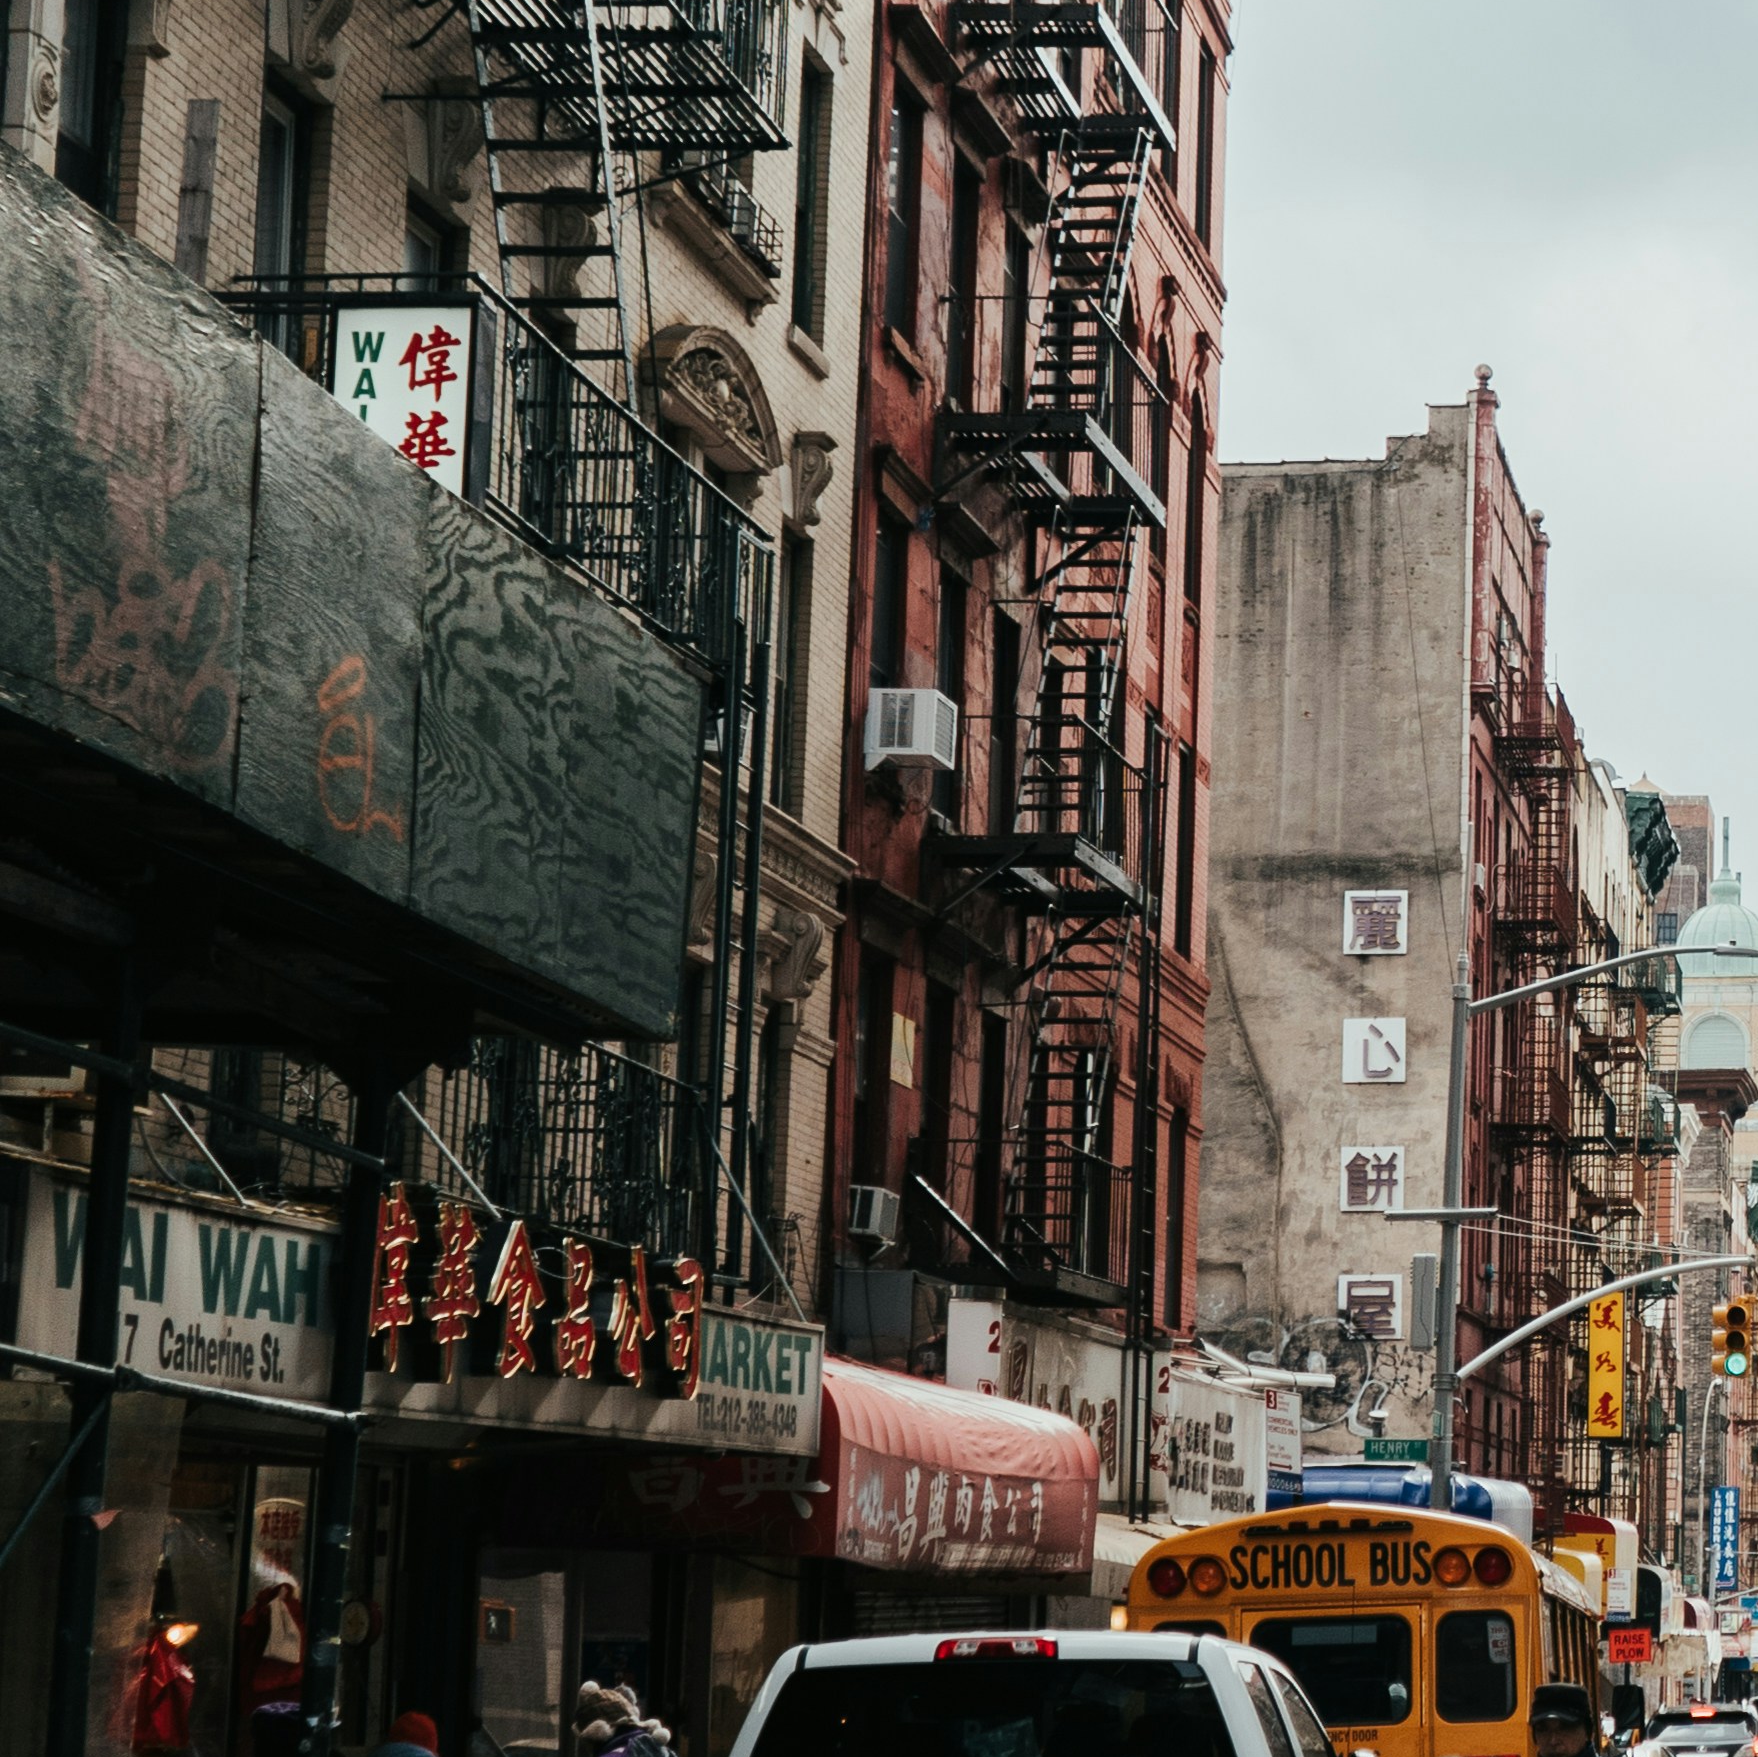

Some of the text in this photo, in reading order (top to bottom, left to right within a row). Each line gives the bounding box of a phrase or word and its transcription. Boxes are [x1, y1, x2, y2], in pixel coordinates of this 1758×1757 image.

[397, 325, 462, 468] 偉華
[198, 1222, 322, 1328] WAH
[158, 1316, 254, 1381] Catherine
[259, 1332, 285, 1384] St.
[1268, 1392, 1276, 1408] 3
[1371, 1442, 1410, 1454] HENRY
[1229, 1541, 1432, 1590] SCHOOL BUS
[1614, 1633, 1645, 1645] RAISE
[1615, 1647, 1645, 1659] PLOW
[1352, 1729, 1378, 1742] DOOR
